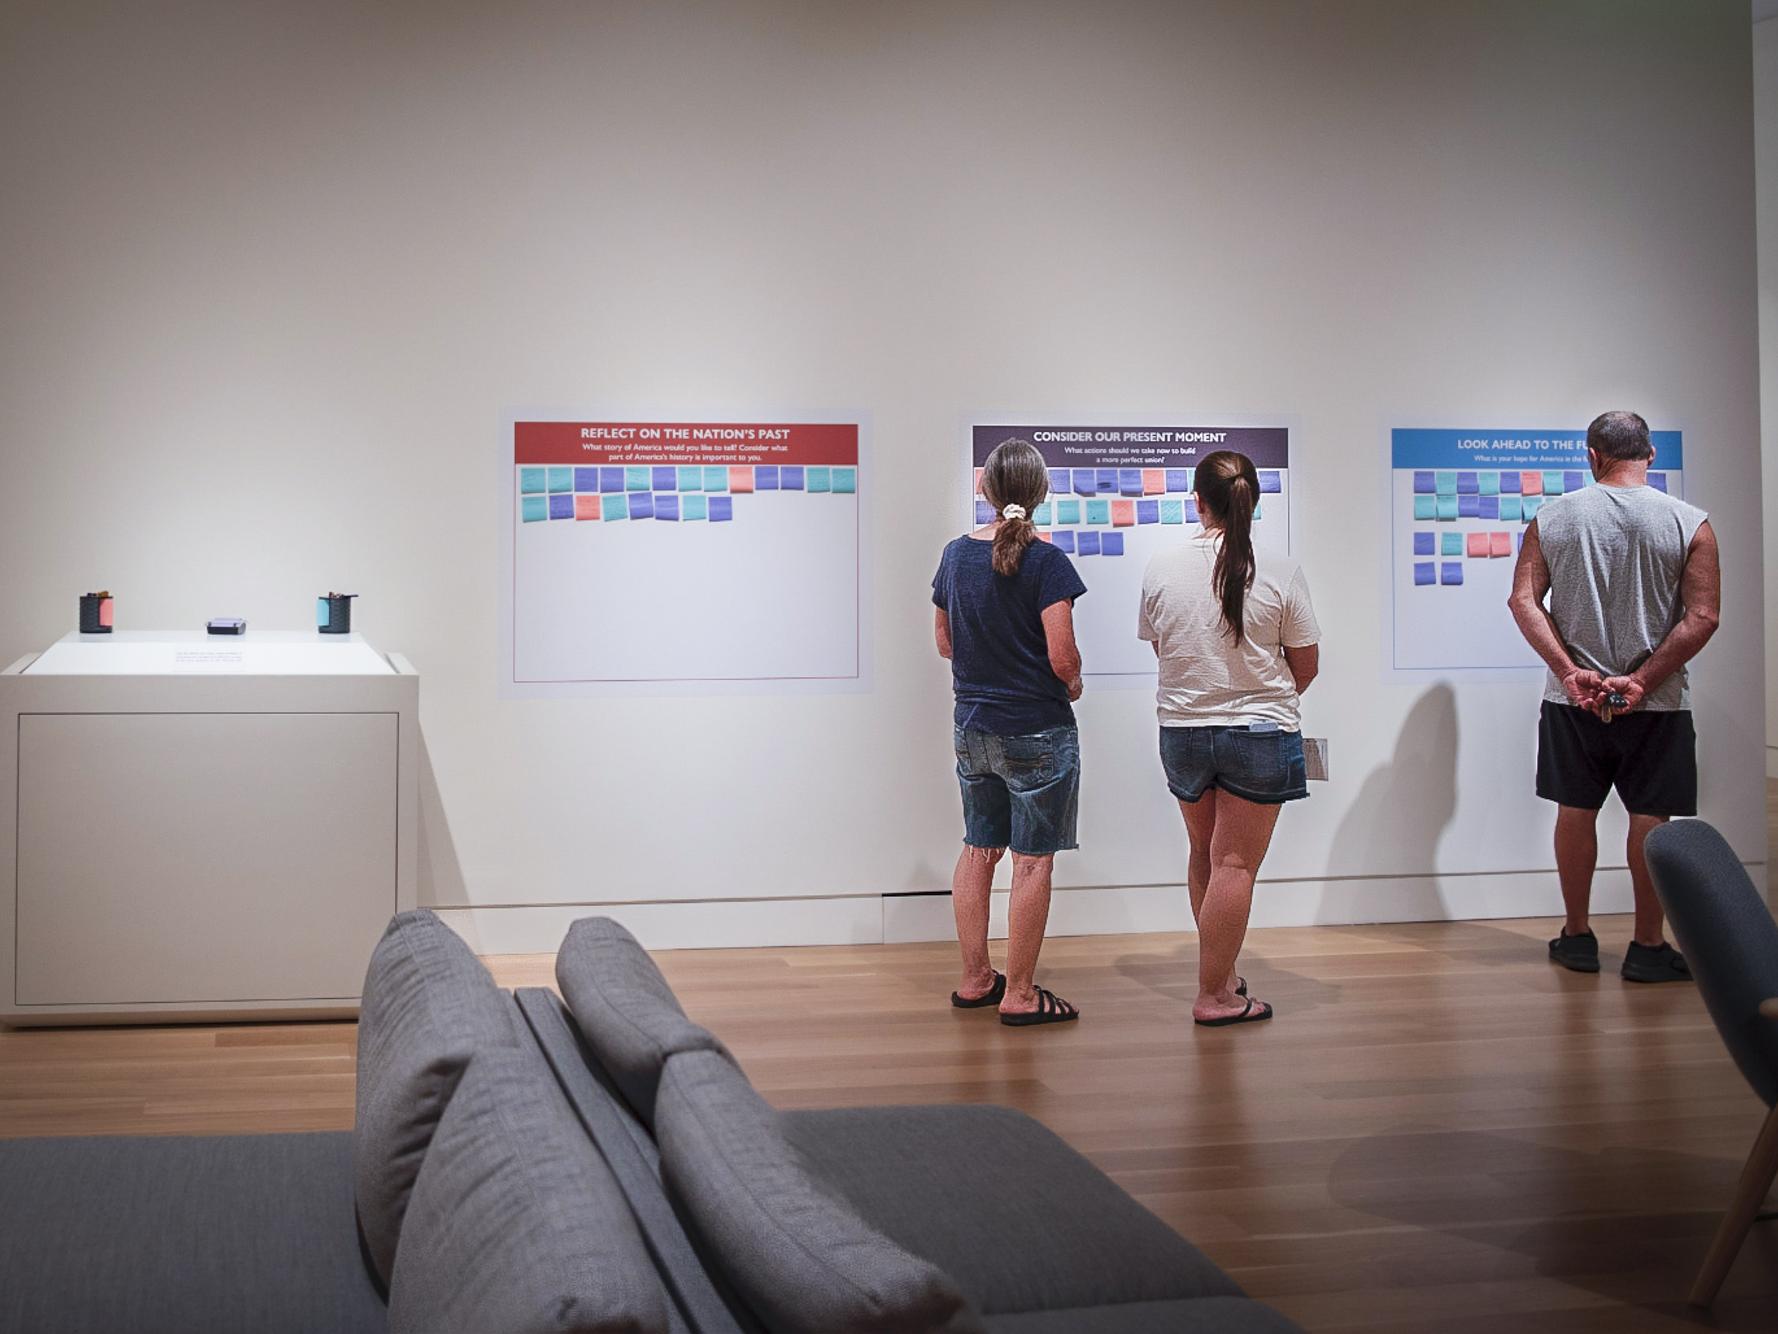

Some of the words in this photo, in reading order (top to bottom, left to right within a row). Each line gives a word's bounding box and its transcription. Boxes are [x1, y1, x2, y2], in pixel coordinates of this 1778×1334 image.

[581, 428, 636, 438] REFLECT
[640, 428, 660, 438] ON
[664, 428, 690, 438] THE
[693, 429, 755, 439] NATION'S
[758, 429, 790, 439] PAST
[1033, 432, 1092, 441] CONSIDER
[1095, 432, 1121, 441] OUR
[1123, 432, 1173, 441] PRESENT
[1175, 433, 1226, 442] MOMENT
[604, 444, 622, 452] story
[1458, 440, 1488, 448] LOOK
[1492, 440, 1531, 449] AHEAD
[1534, 440, 1549, 449] TO
[1552, 441, 1574, 449] THE
[1514, 456, 1528, 464] hope
